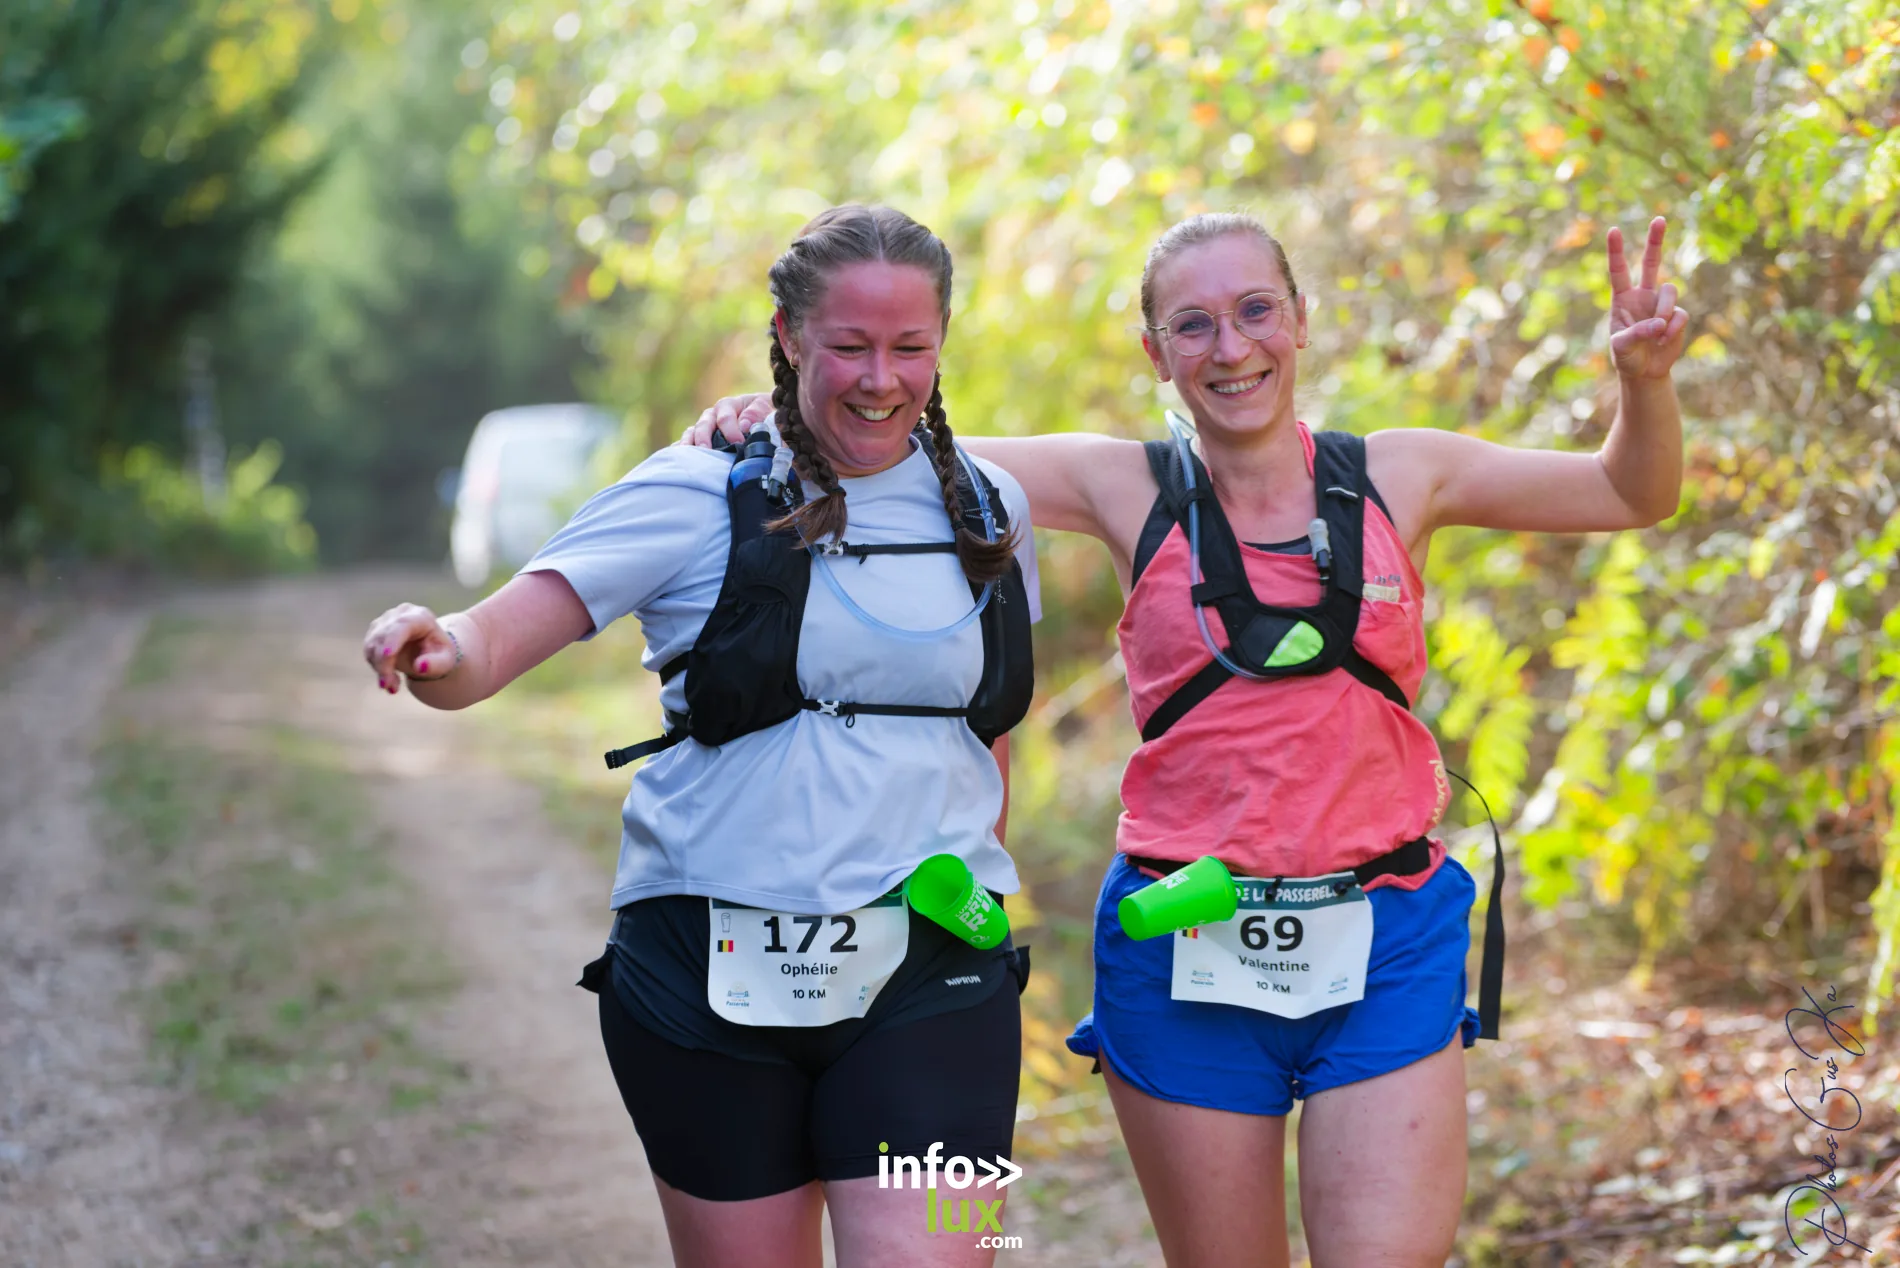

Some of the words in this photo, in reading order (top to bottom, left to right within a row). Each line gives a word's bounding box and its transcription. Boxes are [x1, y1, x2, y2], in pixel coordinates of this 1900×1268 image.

[764, 915, 858, 953] 172
[1240, 915, 1304, 952] 69
[780, 962, 838, 977] Ophélie
[1238, 955, 1310, 972] Valentine
[792, 989, 805, 999] 10
[808, 988, 826, 999] KM
[1256, 980, 1268, 991] 10
[1272, 983, 1291, 994] KM
